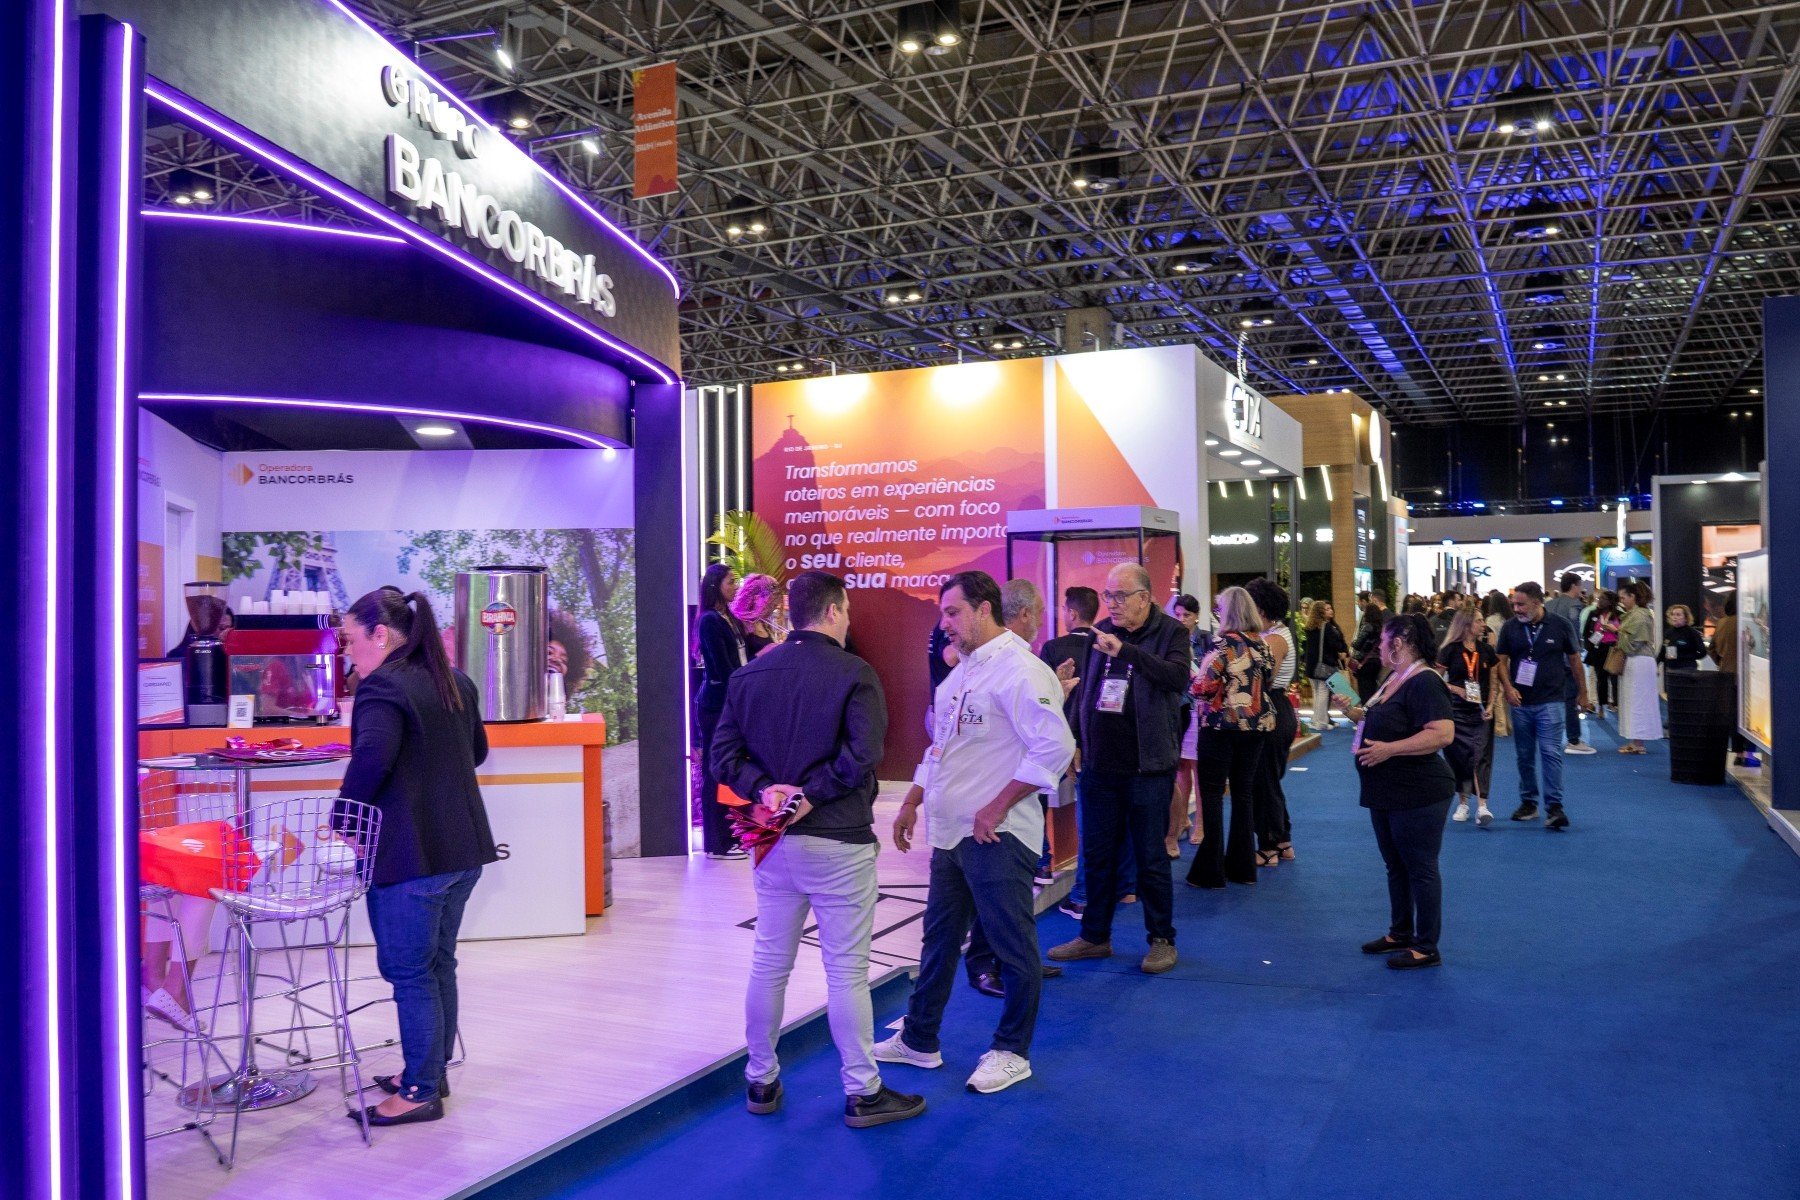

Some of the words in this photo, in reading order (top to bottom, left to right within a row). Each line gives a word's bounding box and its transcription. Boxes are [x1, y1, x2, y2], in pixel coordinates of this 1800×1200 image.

[381, 65, 480, 160] GRUPO
[384, 132, 617, 318] BANCORBRÁS
[258, 472, 355, 485] BANCORBRÁS
[259, 463, 313, 473] Operadora
[785, 459, 917, 480] Transformamos
[784, 485, 847, 502] roteiros
[850, 484, 879, 499] em
[883, 475, 996, 500] experiências
[784, 505, 890, 524] memoráveis
[914, 504, 955, 518] com
[959, 499, 1001, 516] foco
[784, 533, 807, 546] no
[810, 532, 843, 550] que
[846, 526, 936, 544] realmente
[785, 558, 797, 570] o
[801, 553, 841, 570] seu
[844, 552, 906, 570] cliente,
[845, 573, 886, 589] sua
[959, 714, 984, 723] GTA
